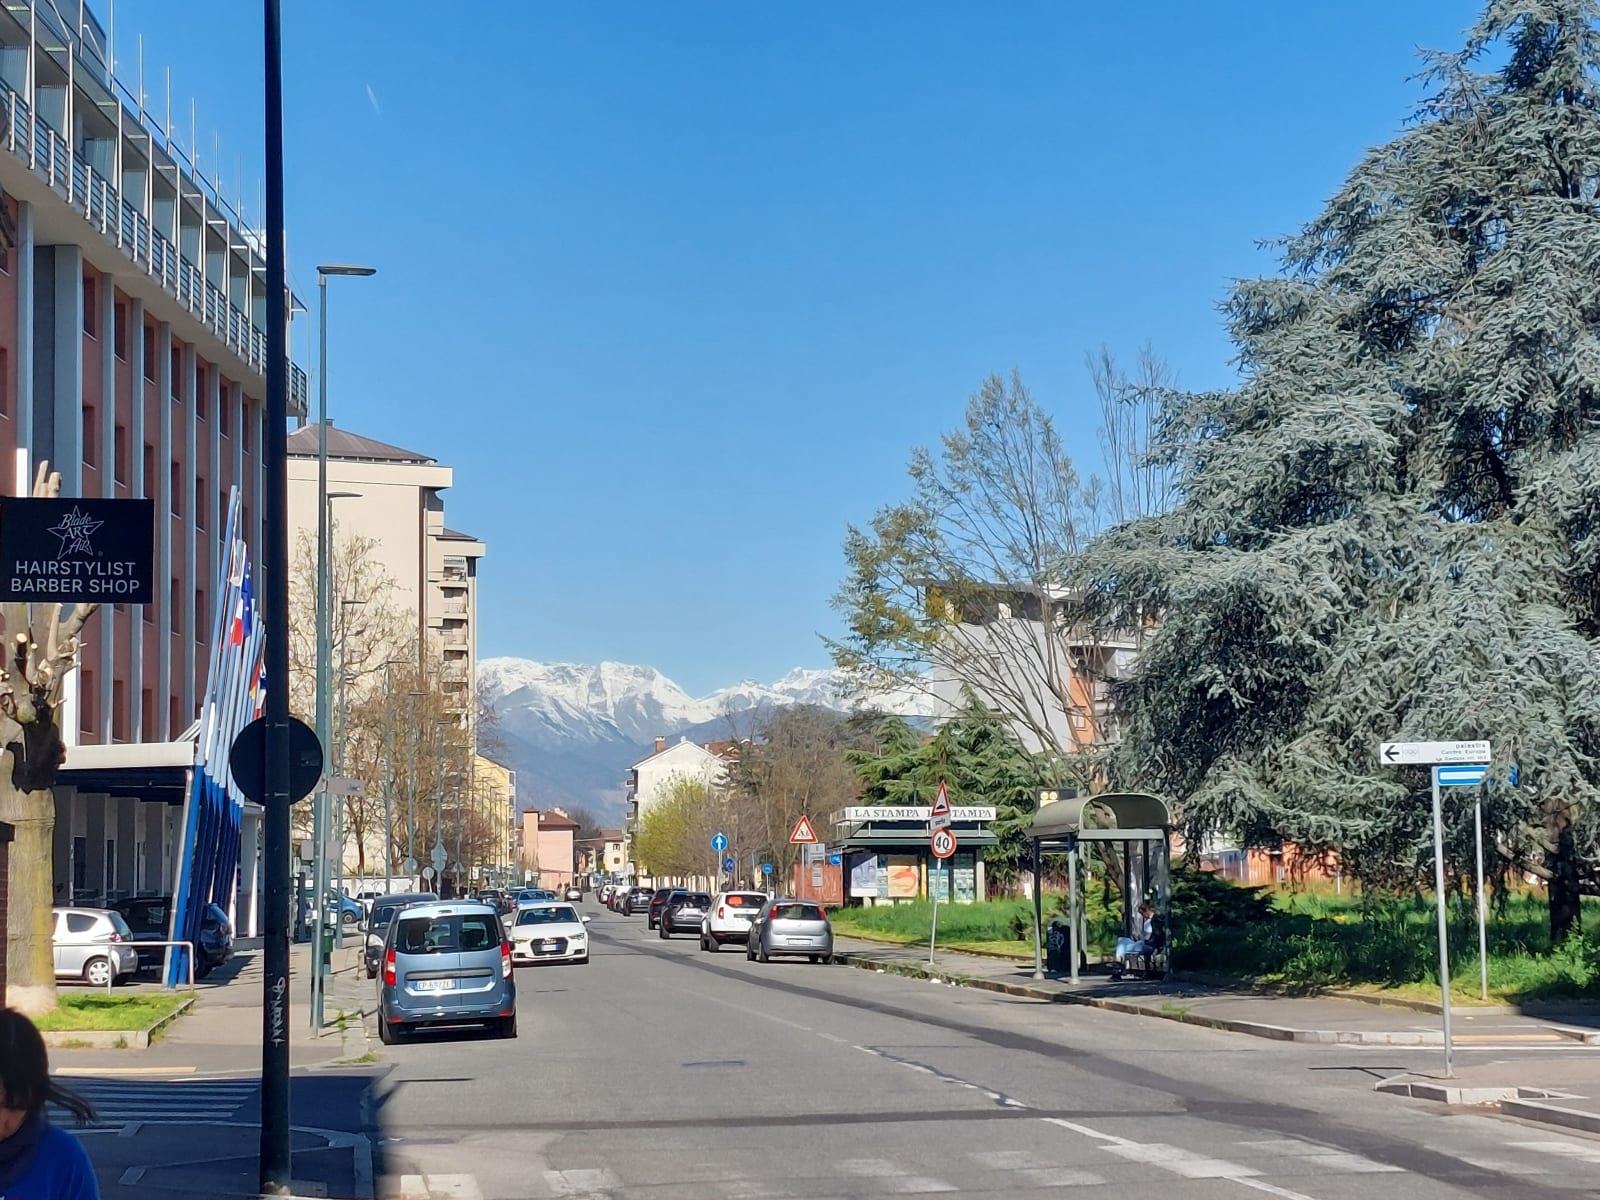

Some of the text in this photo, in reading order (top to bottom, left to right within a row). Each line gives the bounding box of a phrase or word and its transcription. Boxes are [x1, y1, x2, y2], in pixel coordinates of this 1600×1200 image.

[60, 512, 92, 530] Blade
[15, 560, 136, 576] HAIRSTYLIST
[10, 577, 140, 594] BARBER SHOP
[854, 809, 871, 818] LA
[873, 809, 920, 818] STAMPA
[952, 809, 993, 818] TAMPA
[935, 836, 950, 850] 40
